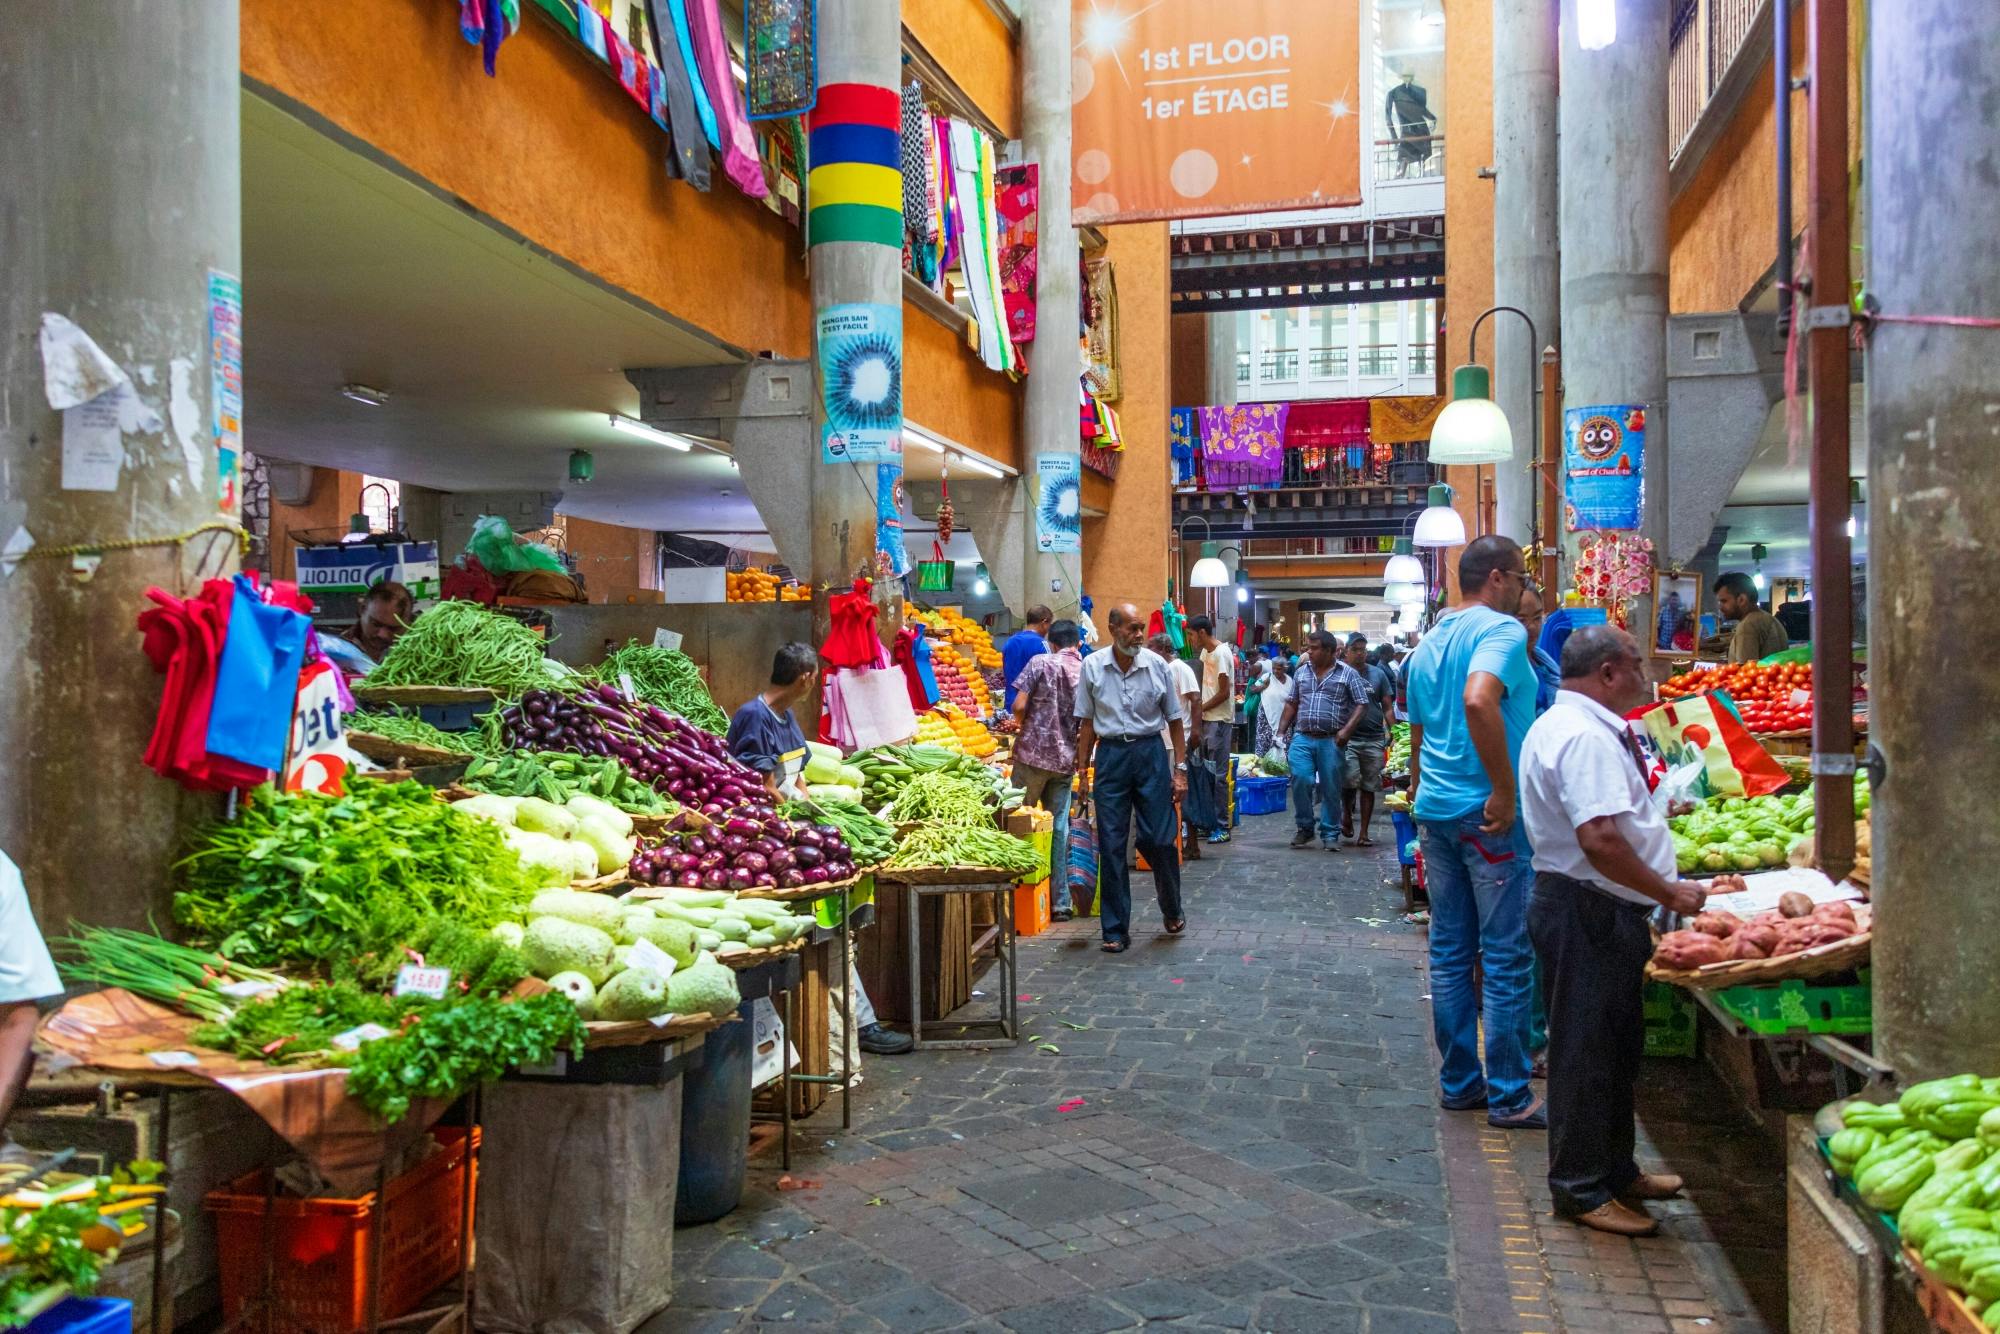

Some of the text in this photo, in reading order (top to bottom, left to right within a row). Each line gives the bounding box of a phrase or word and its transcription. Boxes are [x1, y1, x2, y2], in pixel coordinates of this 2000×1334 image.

[1139, 35, 1289, 71] 1st FLOOR
[1141, 84, 1289, 120] 1er ÉTAGE
[822, 316, 849, 325] MANGER
[303, 568, 362, 585] DUTOIT
